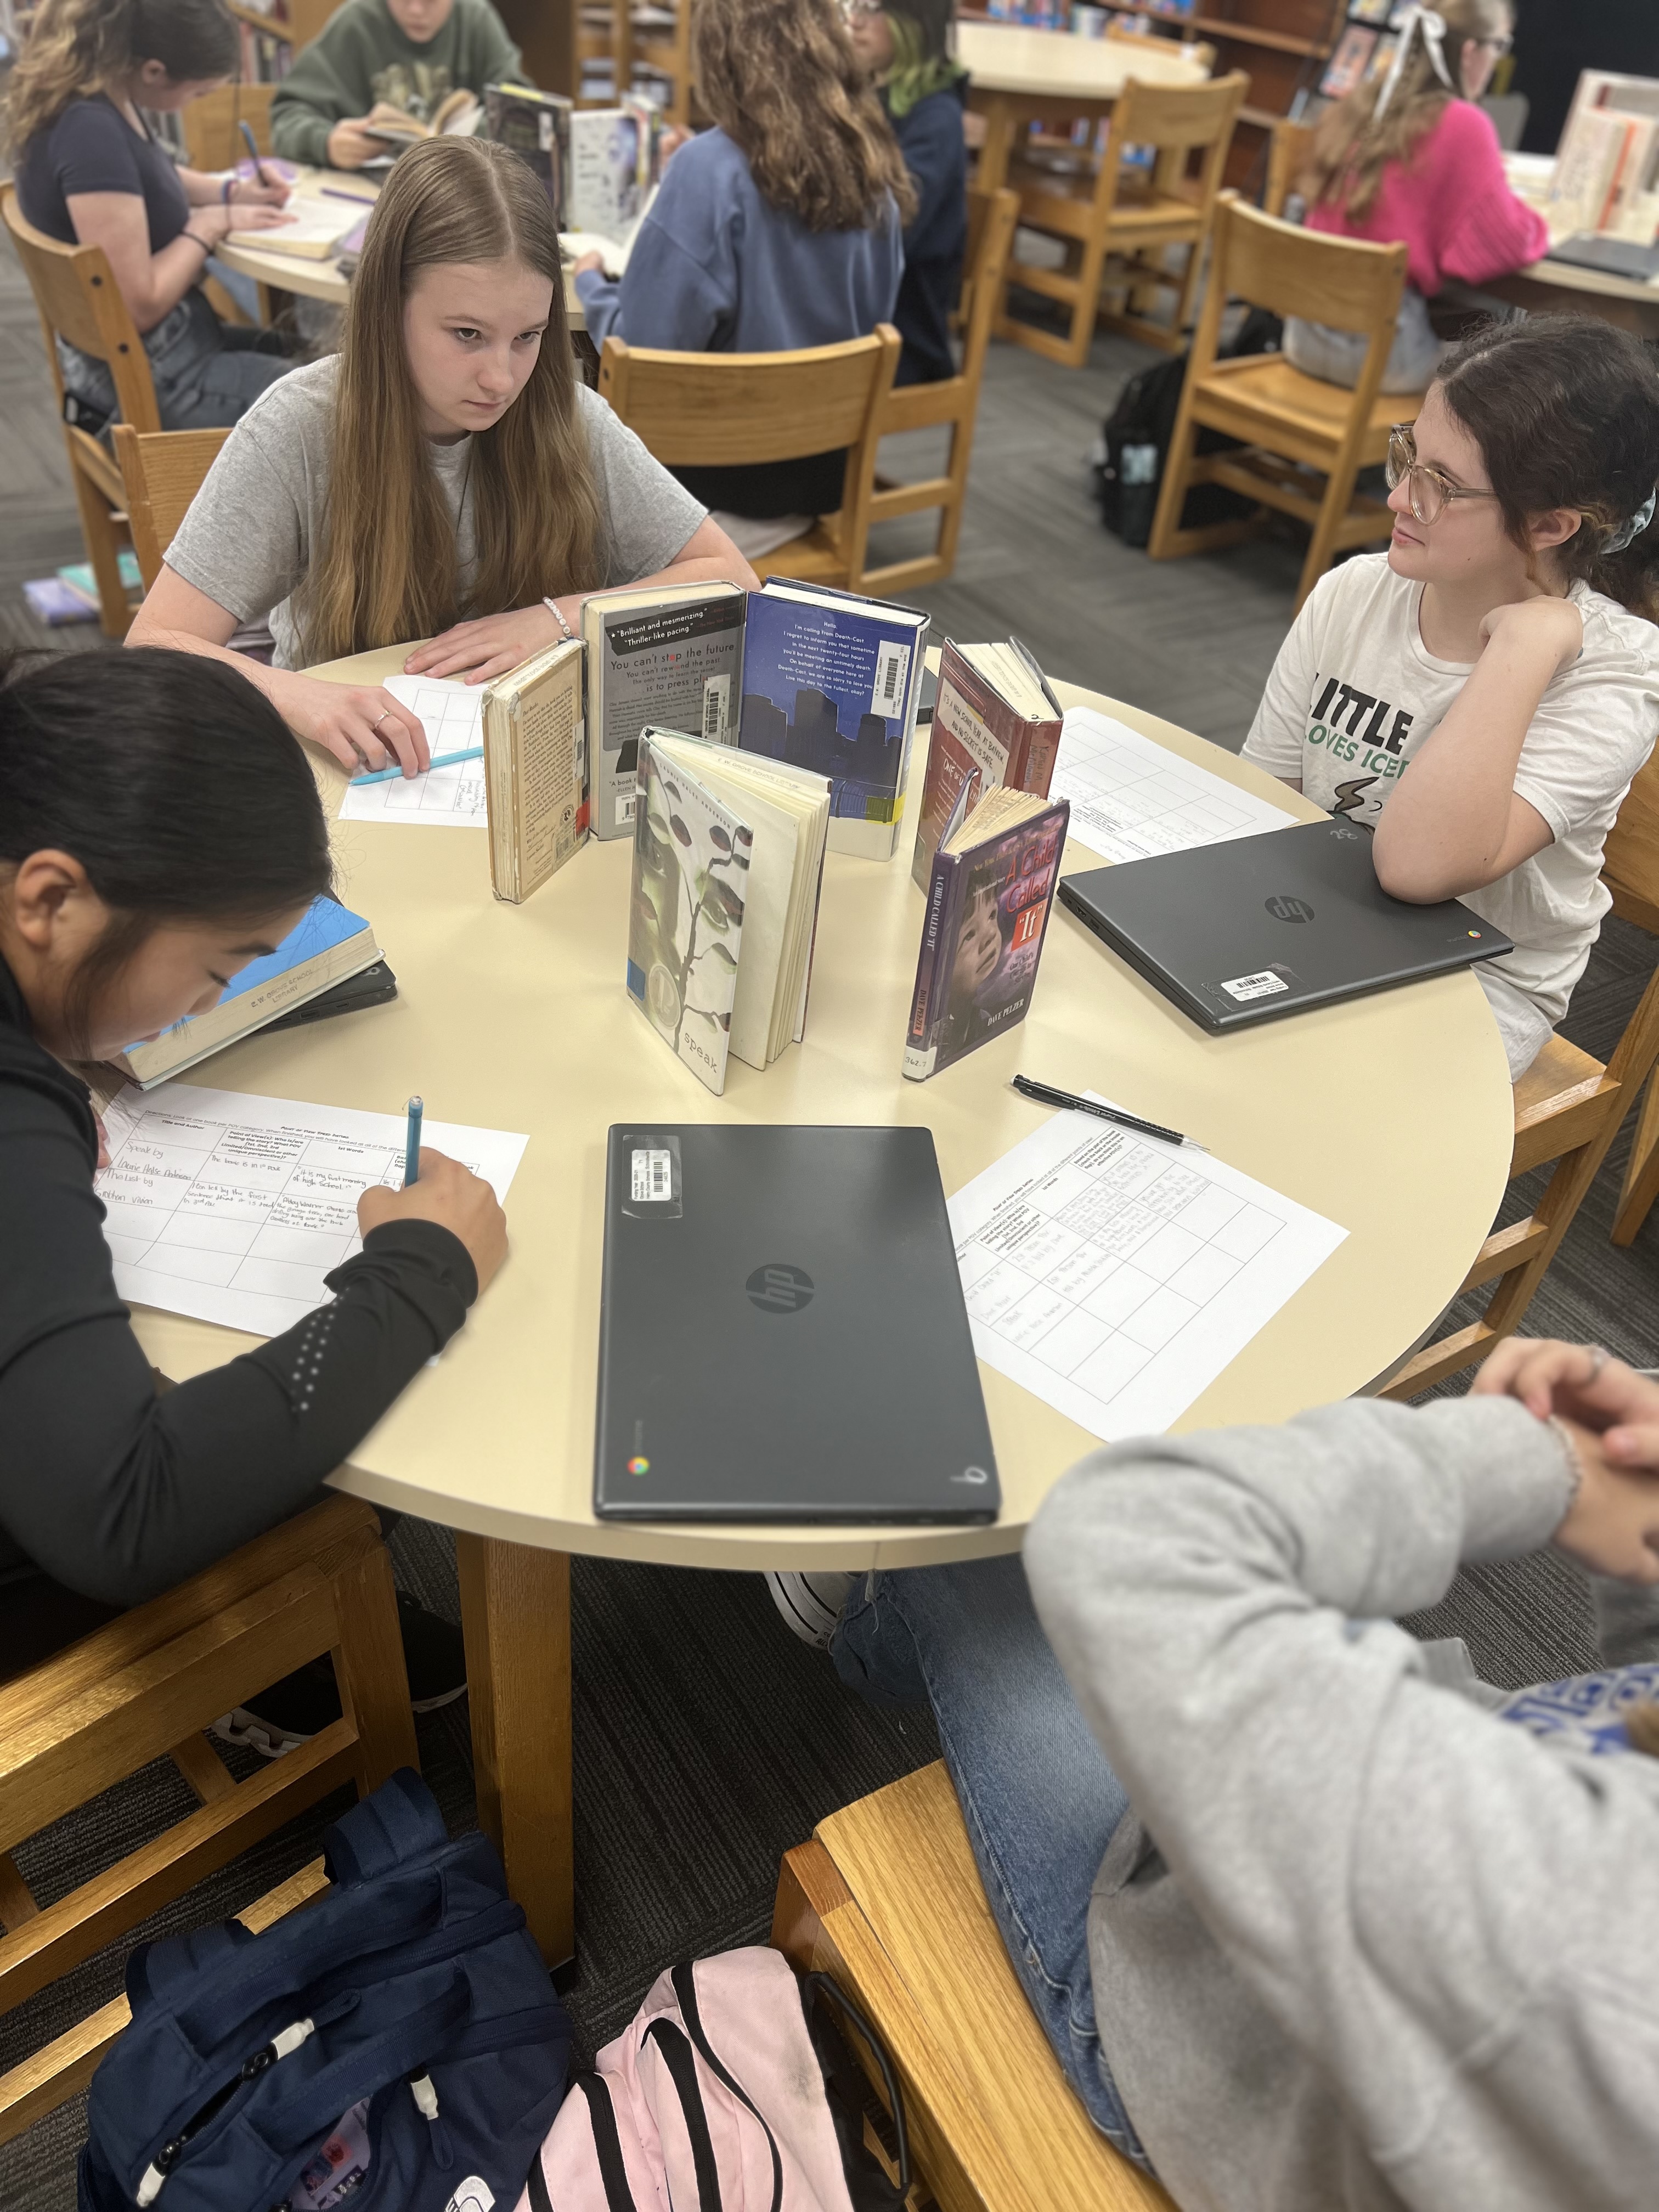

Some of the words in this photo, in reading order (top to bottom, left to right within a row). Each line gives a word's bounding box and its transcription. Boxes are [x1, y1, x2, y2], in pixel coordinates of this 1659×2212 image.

[647, 620, 660, 630] and
[662, 608, 707, 627] mesmerizing."
[667, 623, 693, 637] pacing."
[804, 627, 820, 635] calling
[611, 661, 629, 670] You
[634, 654, 657, 667] can't
[687, 647, 702, 658] the
[821, 648, 850, 658] twenty-four
[851, 645, 875, 654] sometime
[804, 653, 825, 662] meeting
[834, 659, 855, 669] untimely
[823, 666, 844, 675] everyone
[642, 668, 658, 676] can't
[668, 680, 689, 690] press
[1310, 672, 1414, 755] ITTLE
[958, 727, 964, 737] NO
[964, 731, 979, 752] SECRET
[978, 747, 982, 755] IS
[961, 713, 973, 730] SCHOOL
[983, 736, 988, 746] AT
[988, 741, 1004, 764] BAYVIEW,
[1305, 725, 1359, 761] OVES
[732, 763, 752, 773] GROVE
[752, 770, 775, 782] SCHOOL
[944, 758, 955, 777] ONE
[954, 771, 960, 780] OF
[659, 763, 679, 782] LAURIE
[682, 782, 698, 800] HALSE
[701, 800, 731, 830] ANDERSON
[1005, 855, 1017, 885] A
[1022, 834, 1058, 876] Child
[933, 881, 944, 906] CHILD
[1007, 868, 1051, 913] Called
[928, 907, 940, 938] CALLED
[1019, 905, 1043, 943] "It"
[289, 969, 313, 984] SCHOOL
[272, 984, 298, 1003] LIBRARY
[914, 1006, 925, 1032] PELZER
[987, 1011, 1002, 1026] DAVE
[1002, 998, 1024, 1018] PELZER
[684, 1032, 718, 1074] speak
[905, 1056, 927, 1067] 362.7
[126, 1141, 151, 1153] Speak
[153, 1147, 164, 1159] by
[107, 1168, 123, 1180] The
[144, 1177, 153, 1187] by
[302, 1176, 315, 1187] high
[342, 1177, 366, 1189] morning
